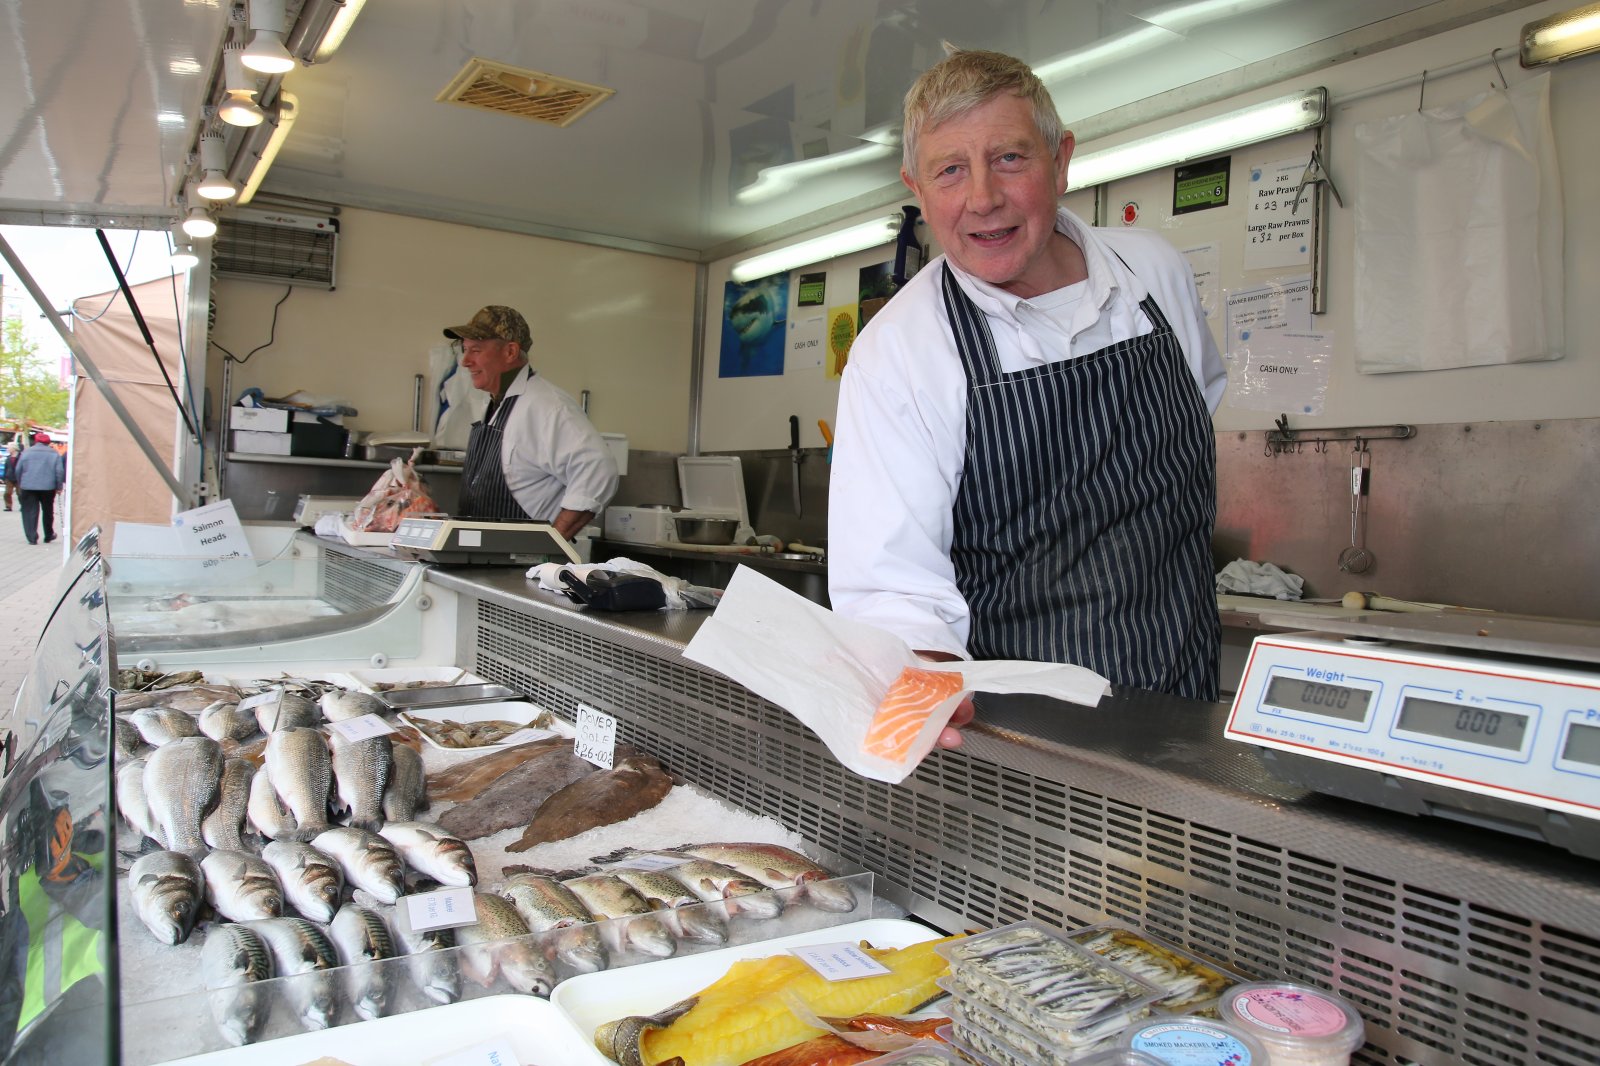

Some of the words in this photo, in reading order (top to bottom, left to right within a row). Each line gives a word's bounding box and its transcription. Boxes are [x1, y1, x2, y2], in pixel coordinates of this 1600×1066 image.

[1259, 189, 1274, 197] Raw
[1276, 185, 1300, 194] Prawn
[1264, 201, 1277, 210] 23
[1248, 223, 1266, 232] Large
[1284, 218, 1309, 228] Prawns
[1260, 232, 1272, 243] 32
[1260, 364, 1278, 373] CASH
[1279, 365, 1298, 374] ONLY
[192, 518, 224, 534] Salmon
[200, 532, 226, 546] Heads
[202, 558, 218, 568] 80p
[1306, 667, 1345, 682] Weight
[1455, 689, 1464, 700] £
[581, 709, 612, 732] DOVER
[581, 725, 609, 744] SOLE
[488, 1051, 501, 1066] Na
